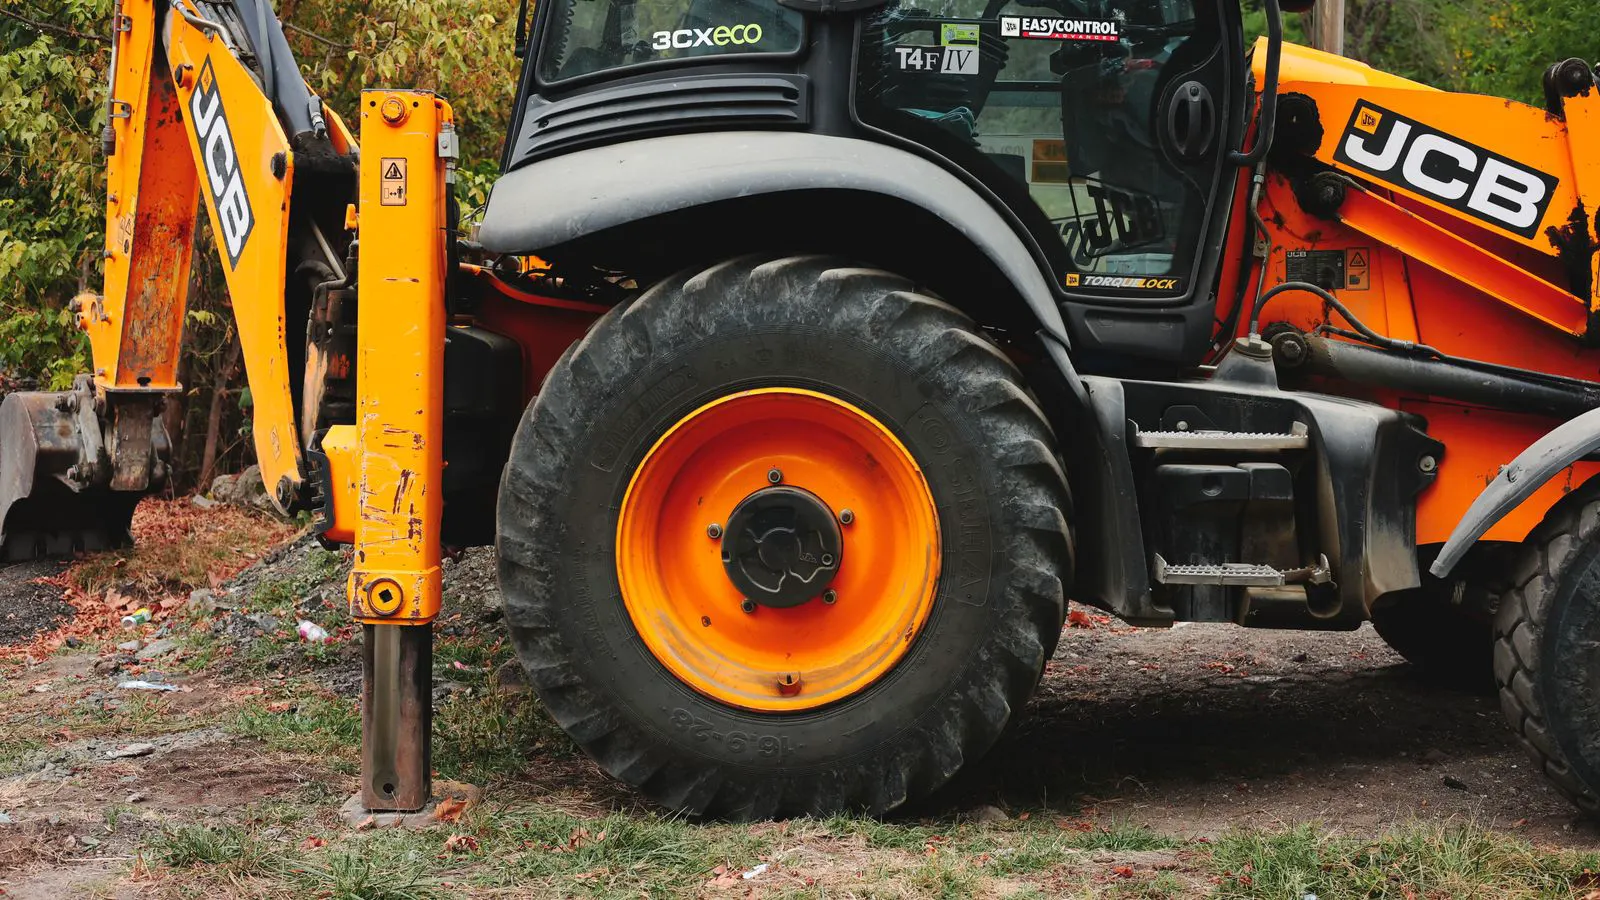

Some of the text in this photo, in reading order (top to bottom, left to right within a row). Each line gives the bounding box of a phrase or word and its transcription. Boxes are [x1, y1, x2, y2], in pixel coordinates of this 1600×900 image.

[1054, 33, 1116, 41] ADVANCED
[895, 47, 973, 71] T4F IV
[192, 85, 250, 258] JCB
[1344, 119, 1547, 229] JCB
[1084, 275, 1177, 289] TORQUELOCK
